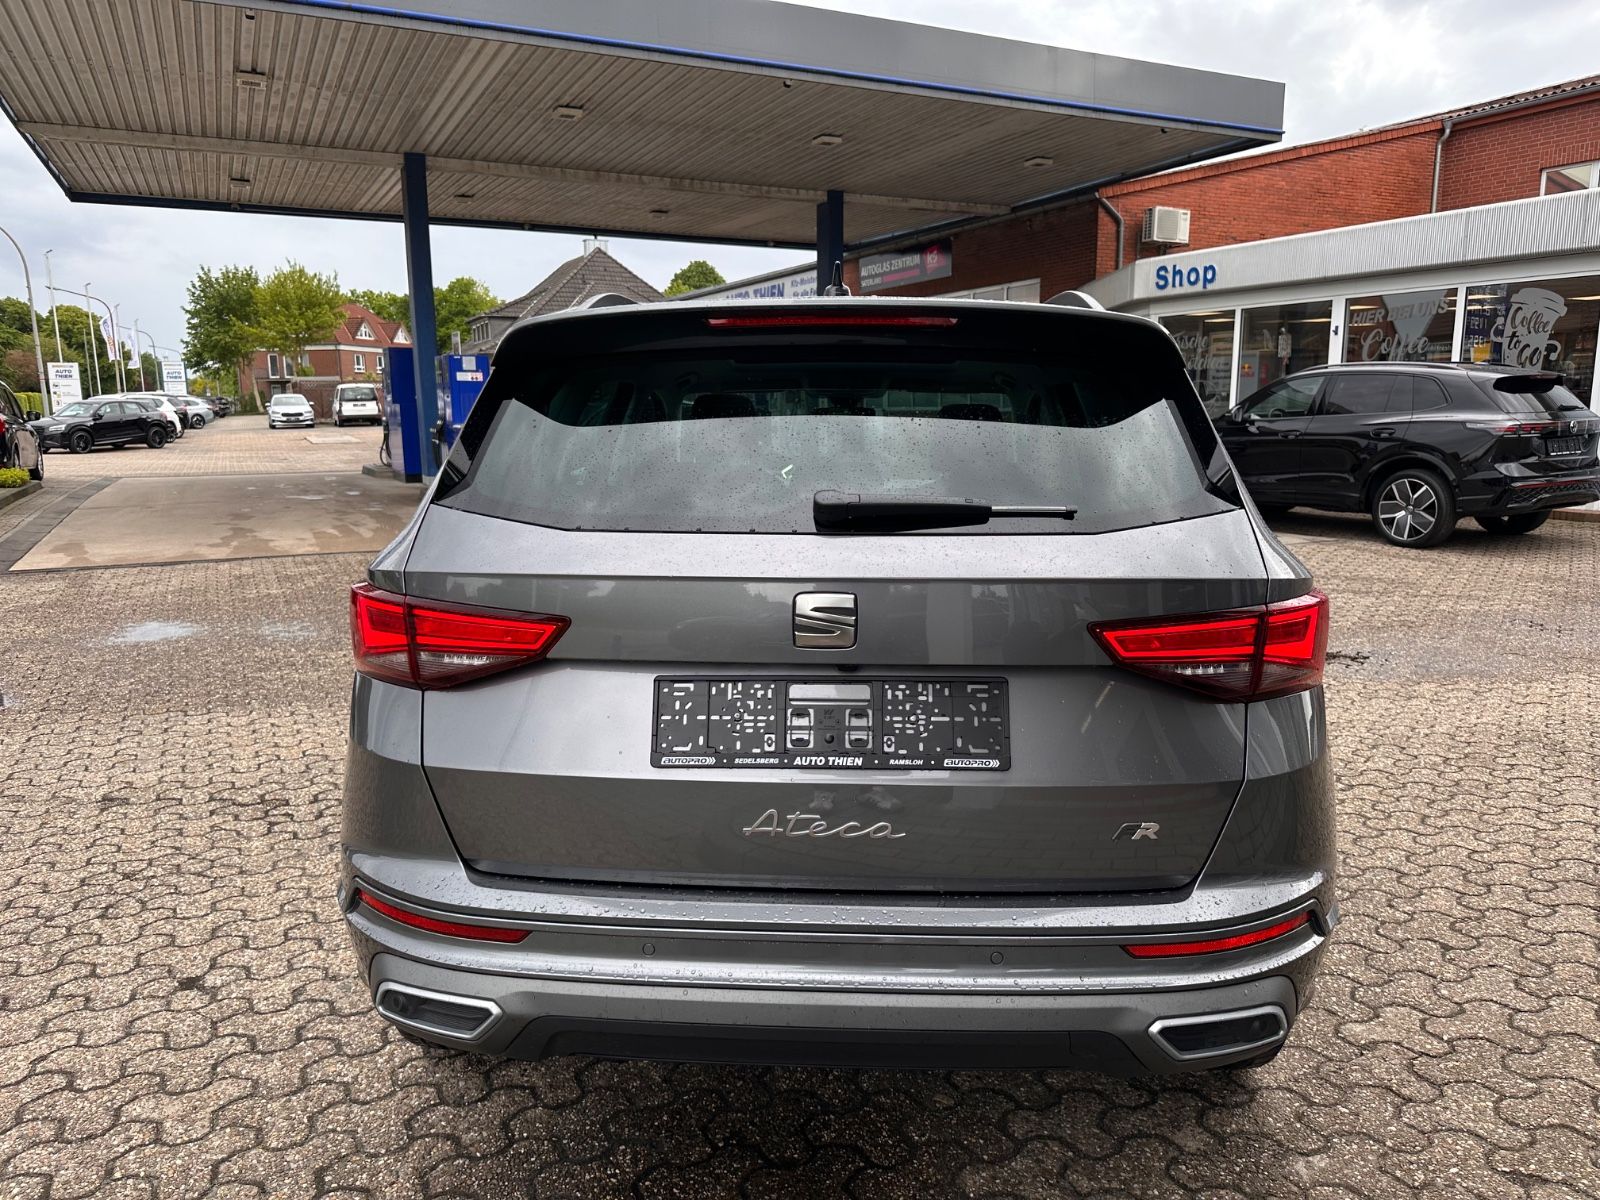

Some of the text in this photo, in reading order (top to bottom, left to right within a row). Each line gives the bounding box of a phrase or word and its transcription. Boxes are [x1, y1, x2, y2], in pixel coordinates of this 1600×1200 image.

[861, 253, 921, 277] AUTOGLAS ZENTRUM
[1155, 264, 1217, 290] Shop
[753, 282, 785, 298] THIEN
[1351, 299, 1450, 326] HIER BEI UNS
[1510, 306, 1551, 335] Coffee
[1360, 329, 1429, 361] Coffee
[1505, 331, 1523, 350] to
[1517, 343, 1542, 368] GO
[793, 756, 863, 766] AUTO THIEN
[742, 808, 906, 839] Ateca
[1111, 822, 1160, 840] FR
